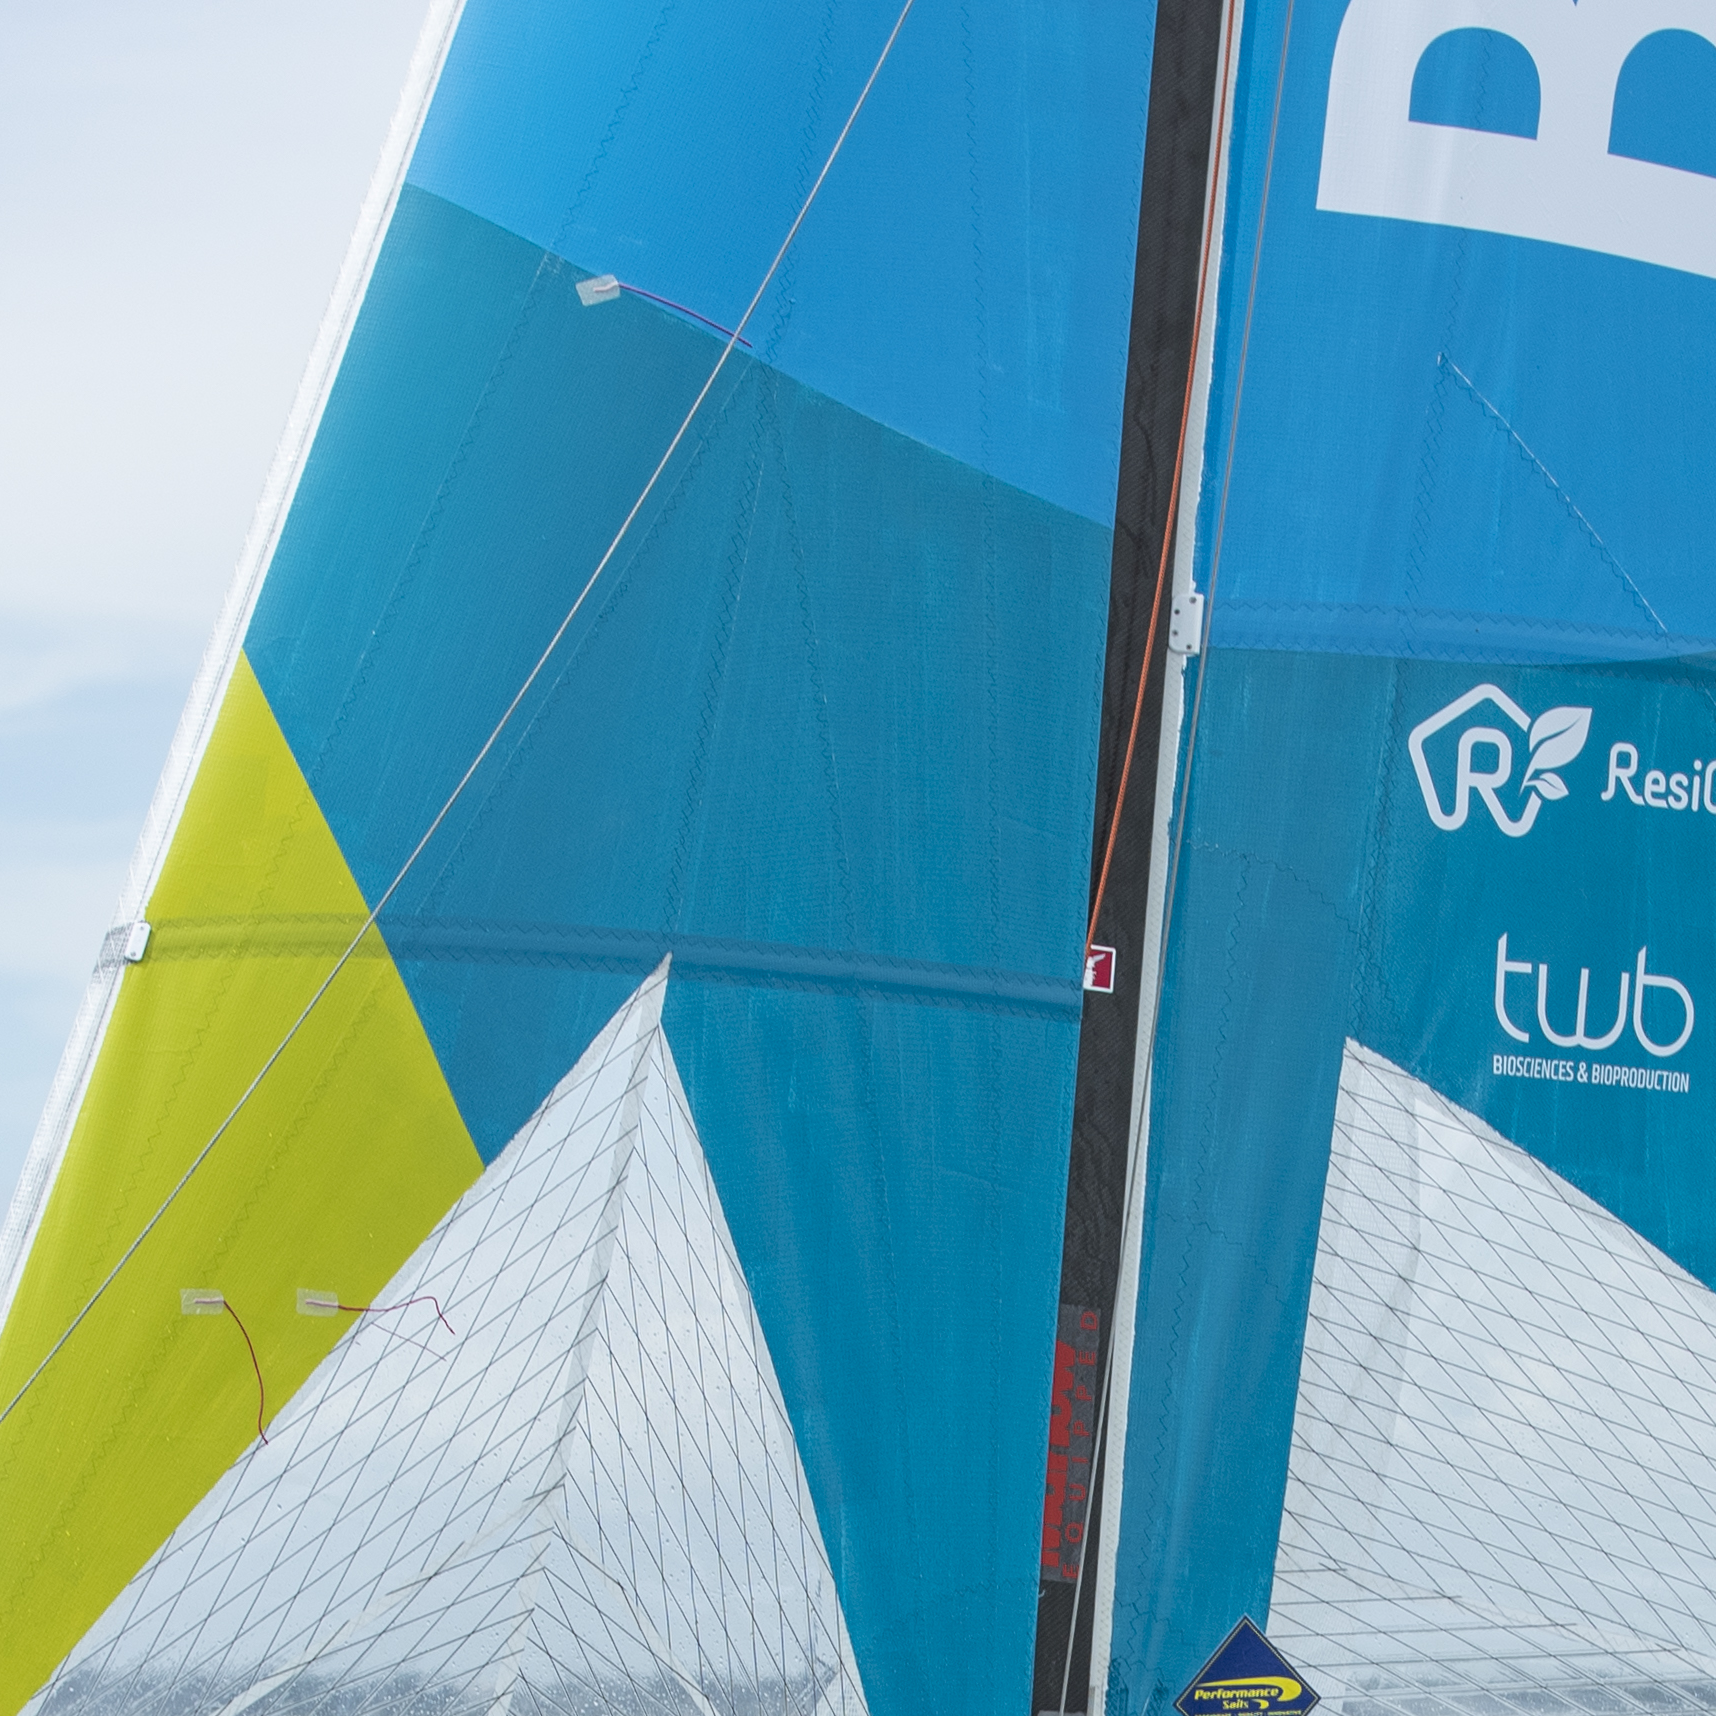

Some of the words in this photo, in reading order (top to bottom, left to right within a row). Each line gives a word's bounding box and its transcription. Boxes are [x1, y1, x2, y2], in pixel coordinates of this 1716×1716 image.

[1494, 931, 1695, 1058] twb
[1492, 1053, 1574, 1082] BIOSCIENCES
[1576, 1061, 1589, 1084] &
[1590, 1063, 1690, 1094] BIOPRODUCTION
[1062, 1310, 1098, 1580] EQUIPPED
[1194, 1687, 1280, 1701] Performance
[1222, 1698, 1249, 1710] Sails
